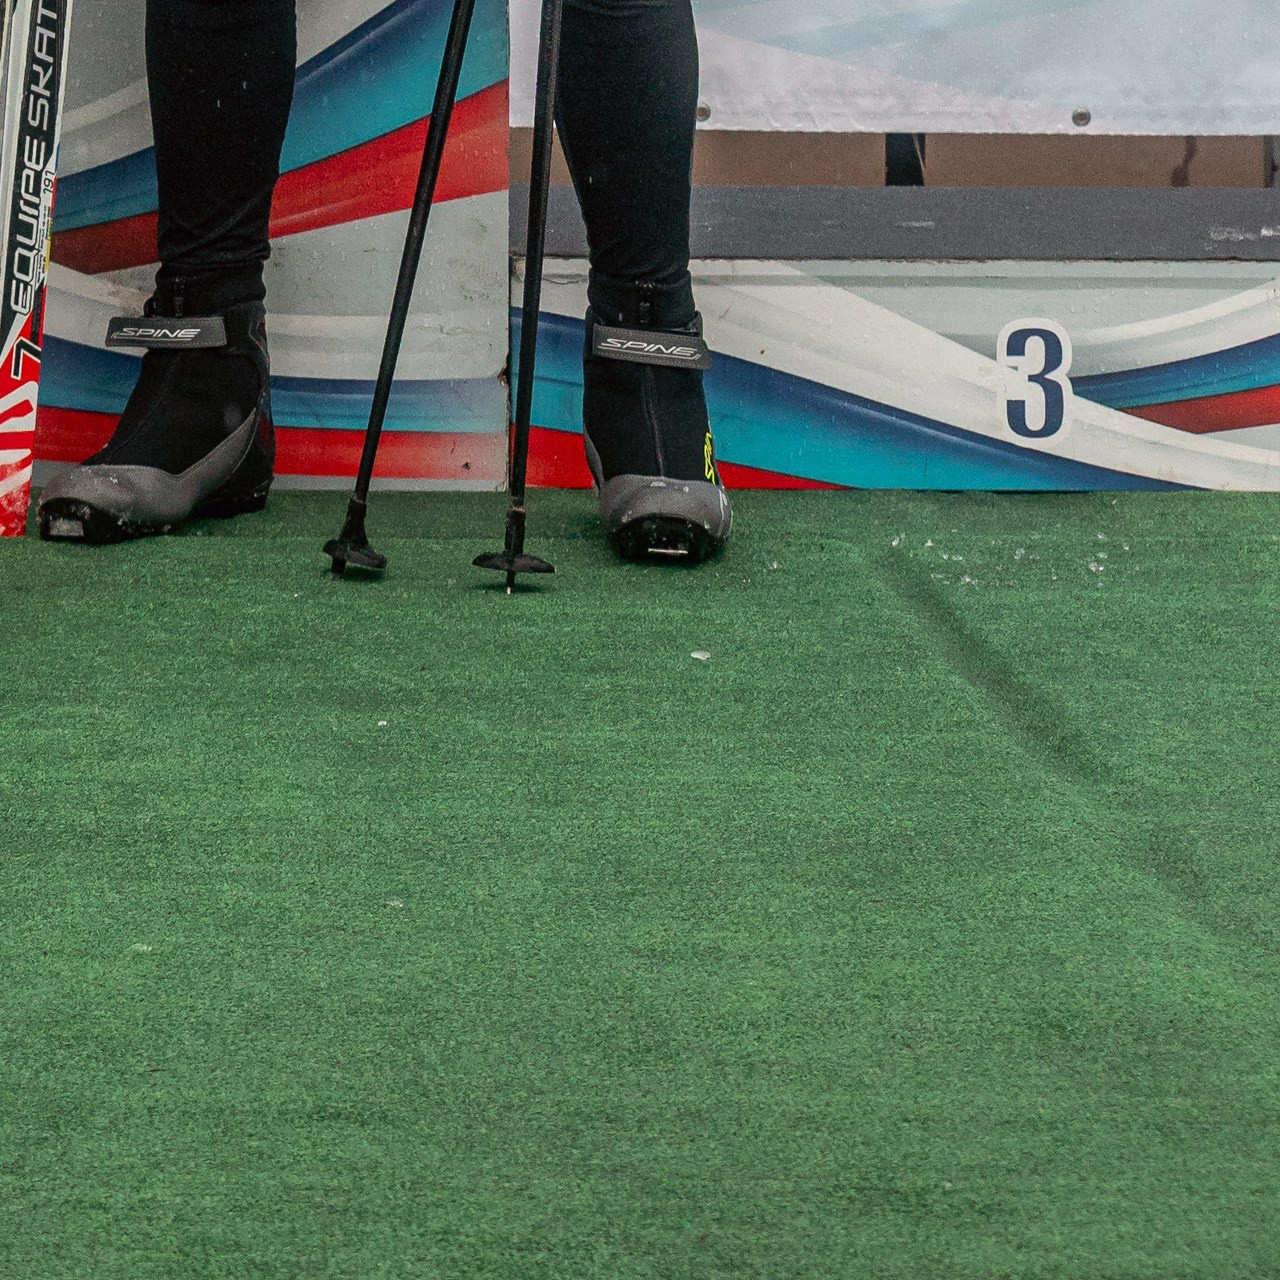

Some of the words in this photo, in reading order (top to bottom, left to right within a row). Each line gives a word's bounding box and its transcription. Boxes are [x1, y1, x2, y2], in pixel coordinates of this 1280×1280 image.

[10, 136, 46, 315] EQUIPE
[119, 326, 201, 339] SPINE
[604, 338, 699, 357] SPINE
[1005, 329, 1063, 437] 3
